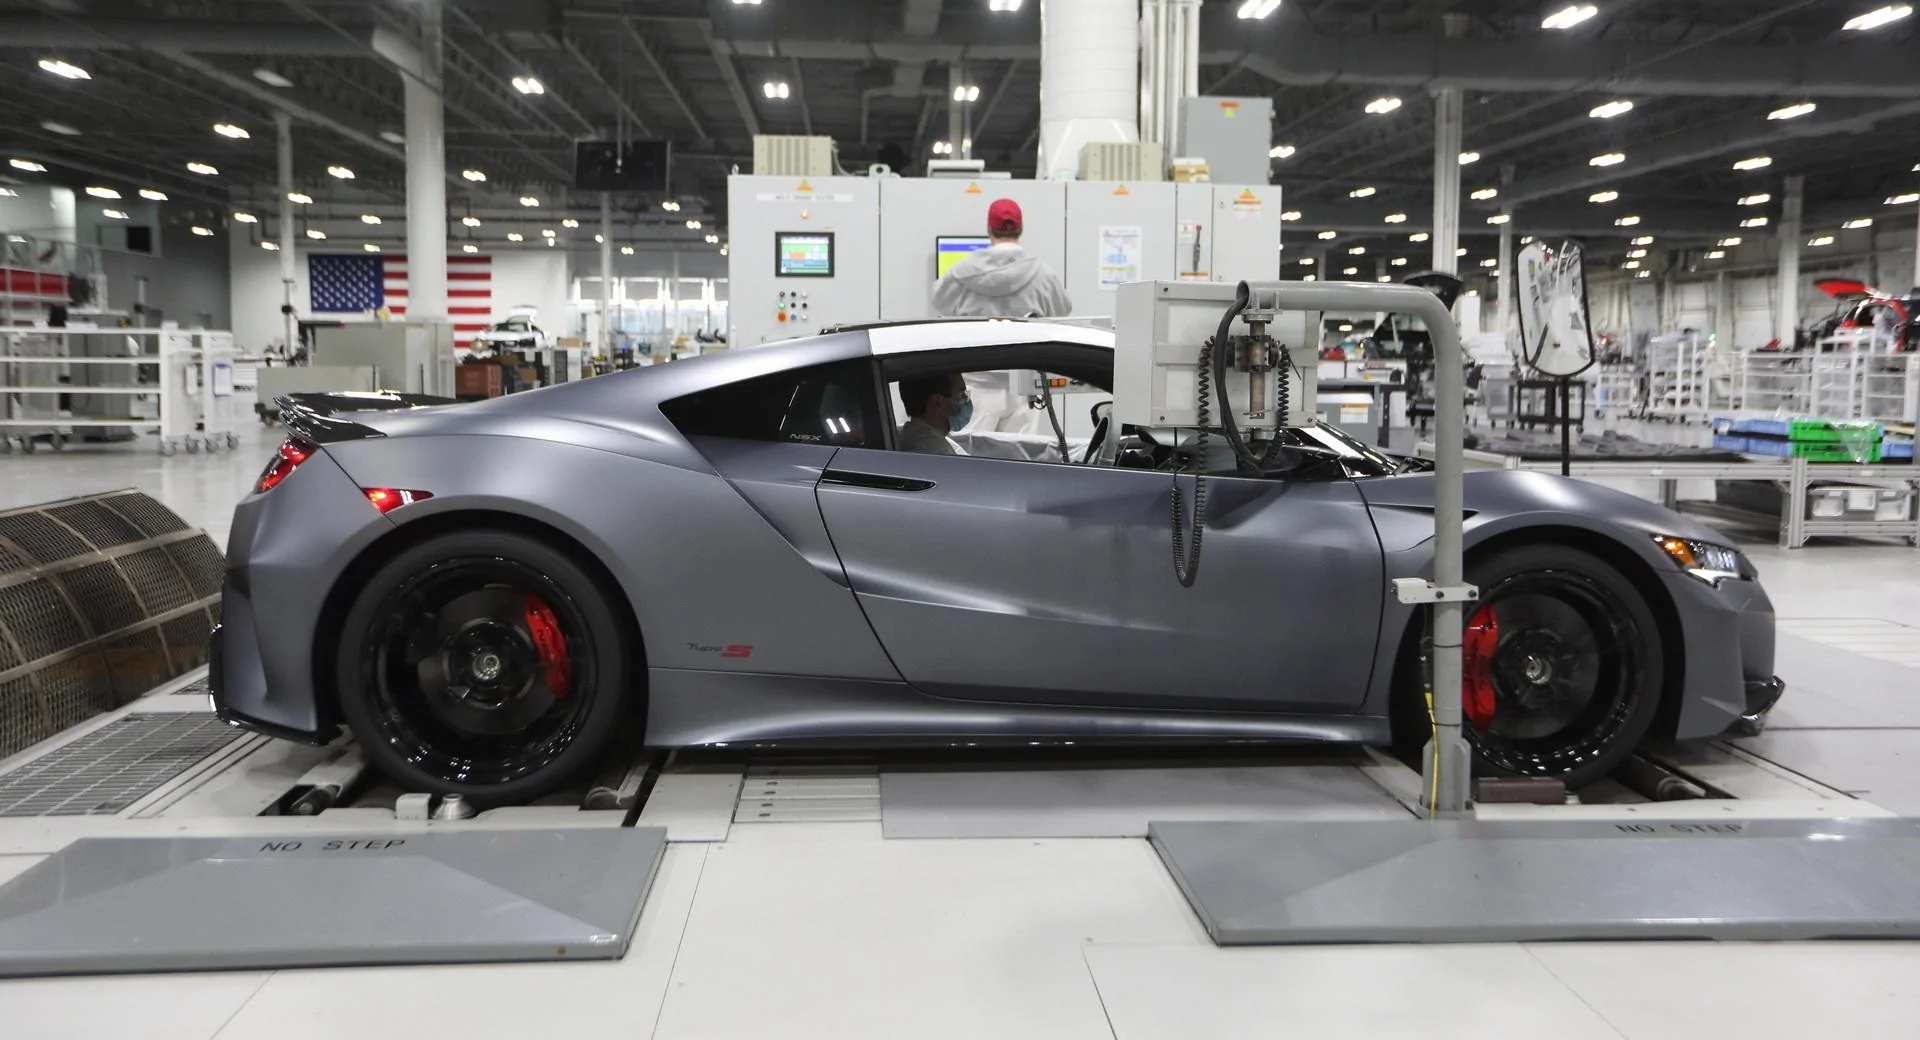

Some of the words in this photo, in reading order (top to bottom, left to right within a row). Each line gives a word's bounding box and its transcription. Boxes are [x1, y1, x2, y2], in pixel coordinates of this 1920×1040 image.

[790, 433, 822, 441] NSX
[686, 642, 723, 651] Type
[720, 644, 754, 658] S
[1615, 824, 1656, 832] NO
[1670, 824, 1742, 833] STEP
[259, 841, 303, 851] NO
[323, 839, 405, 850] STEP
